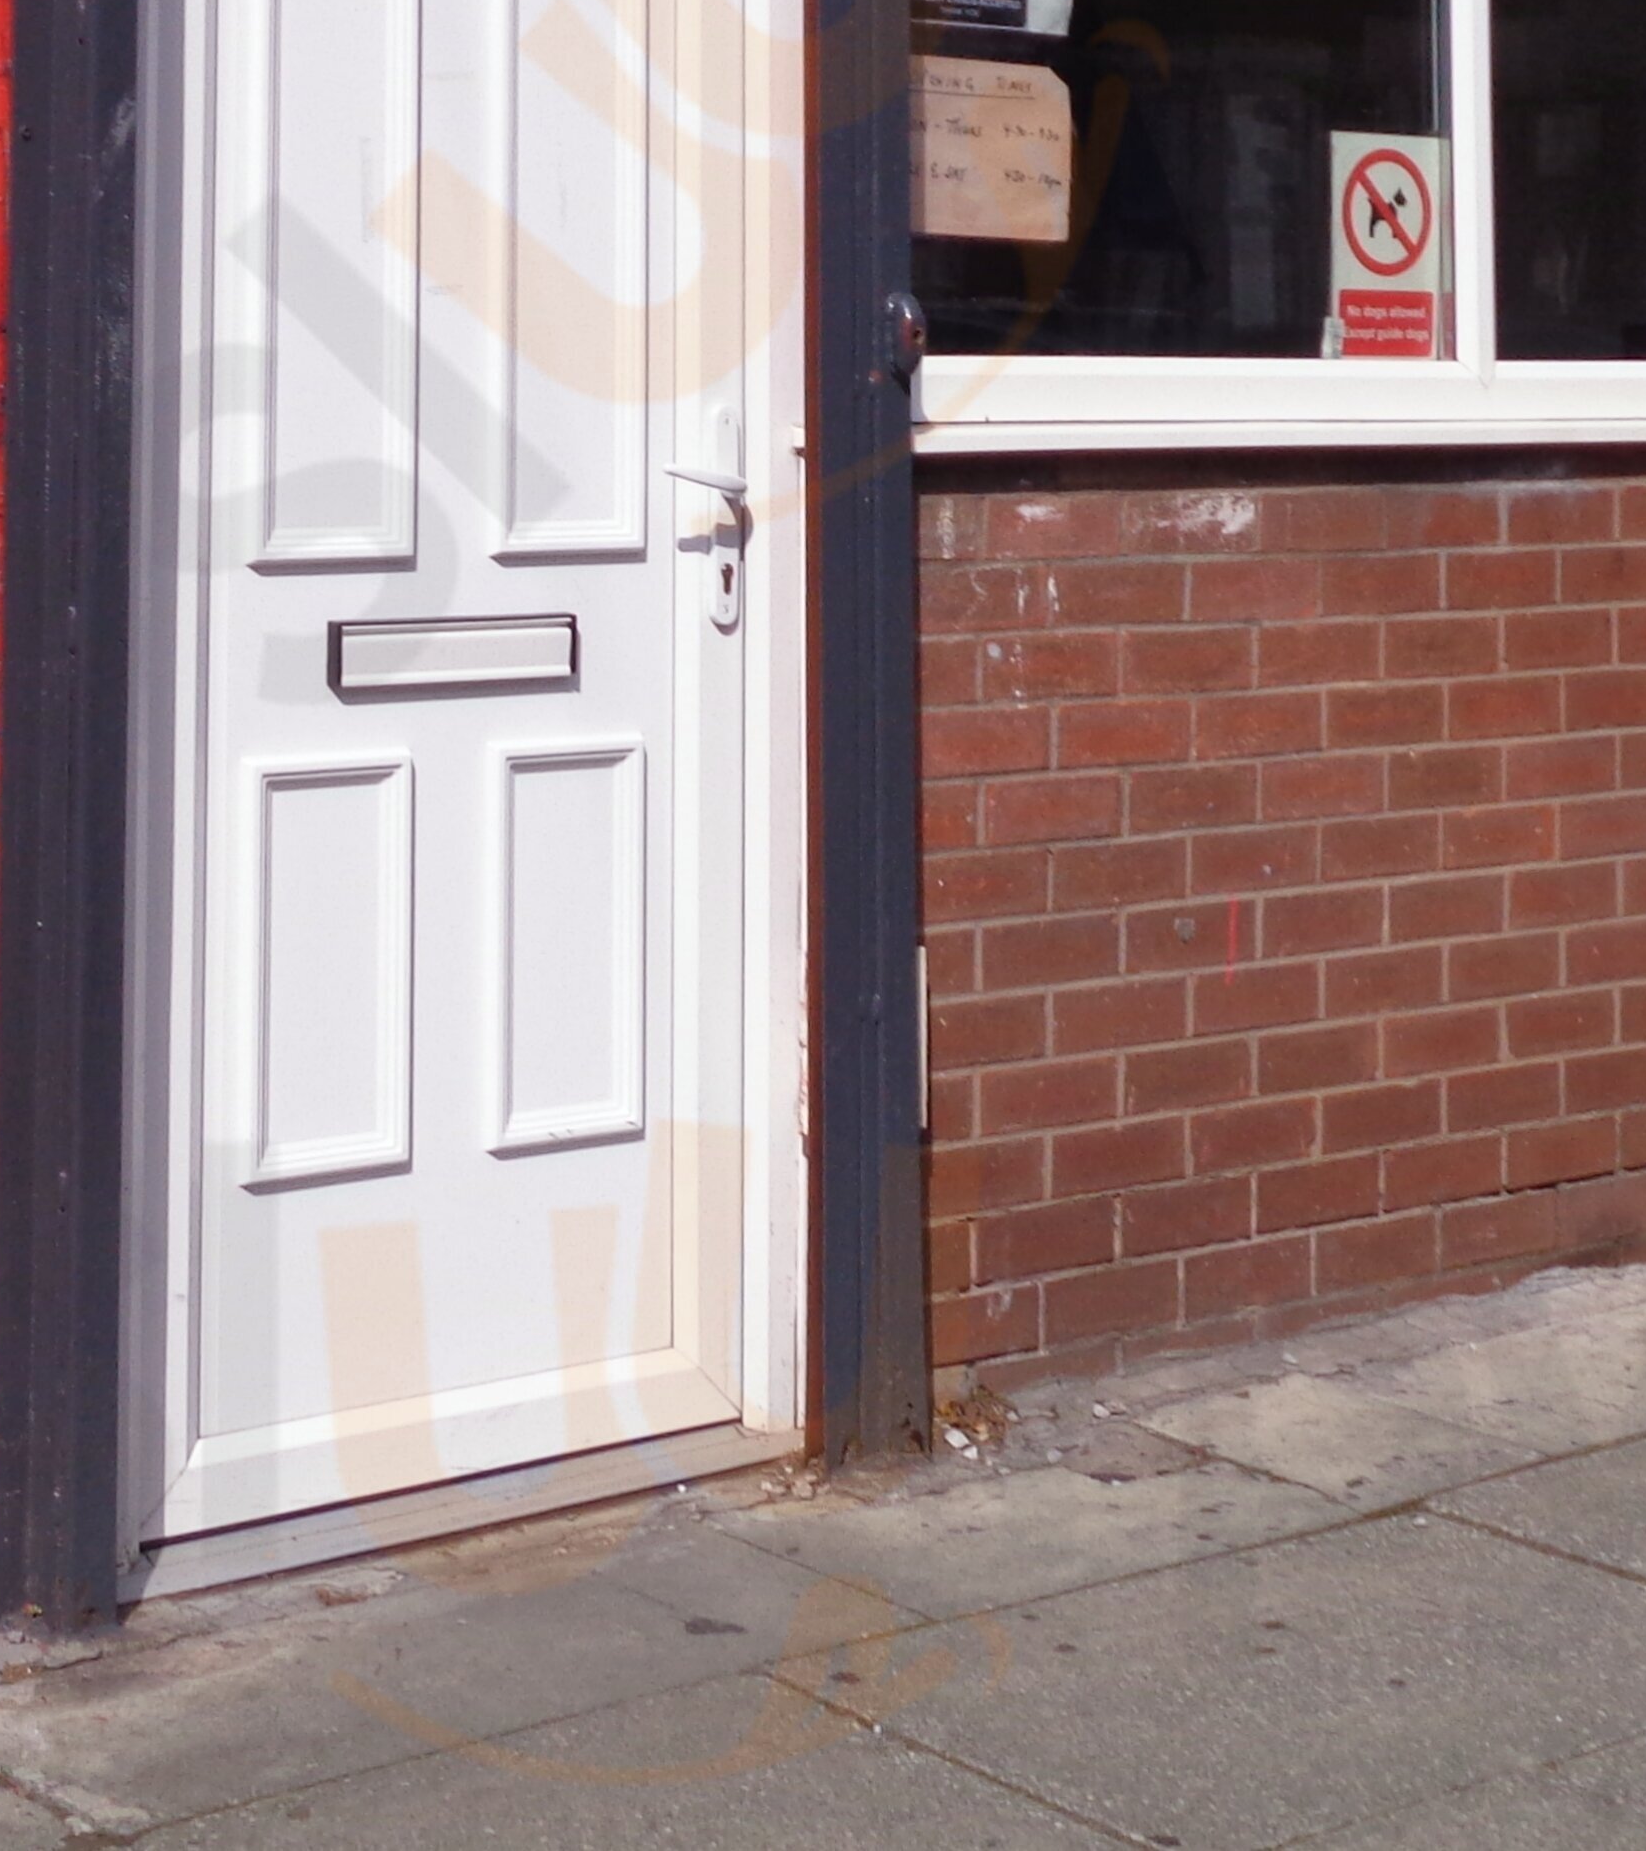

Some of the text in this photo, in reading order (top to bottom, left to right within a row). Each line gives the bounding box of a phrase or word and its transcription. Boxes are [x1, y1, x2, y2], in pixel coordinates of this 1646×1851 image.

[1363, 305, 1388, 320] dogs
[1389, 306, 1426, 318] allowed
[1376, 327, 1404, 341] guide
[1405, 327, 1430, 342] dogs
